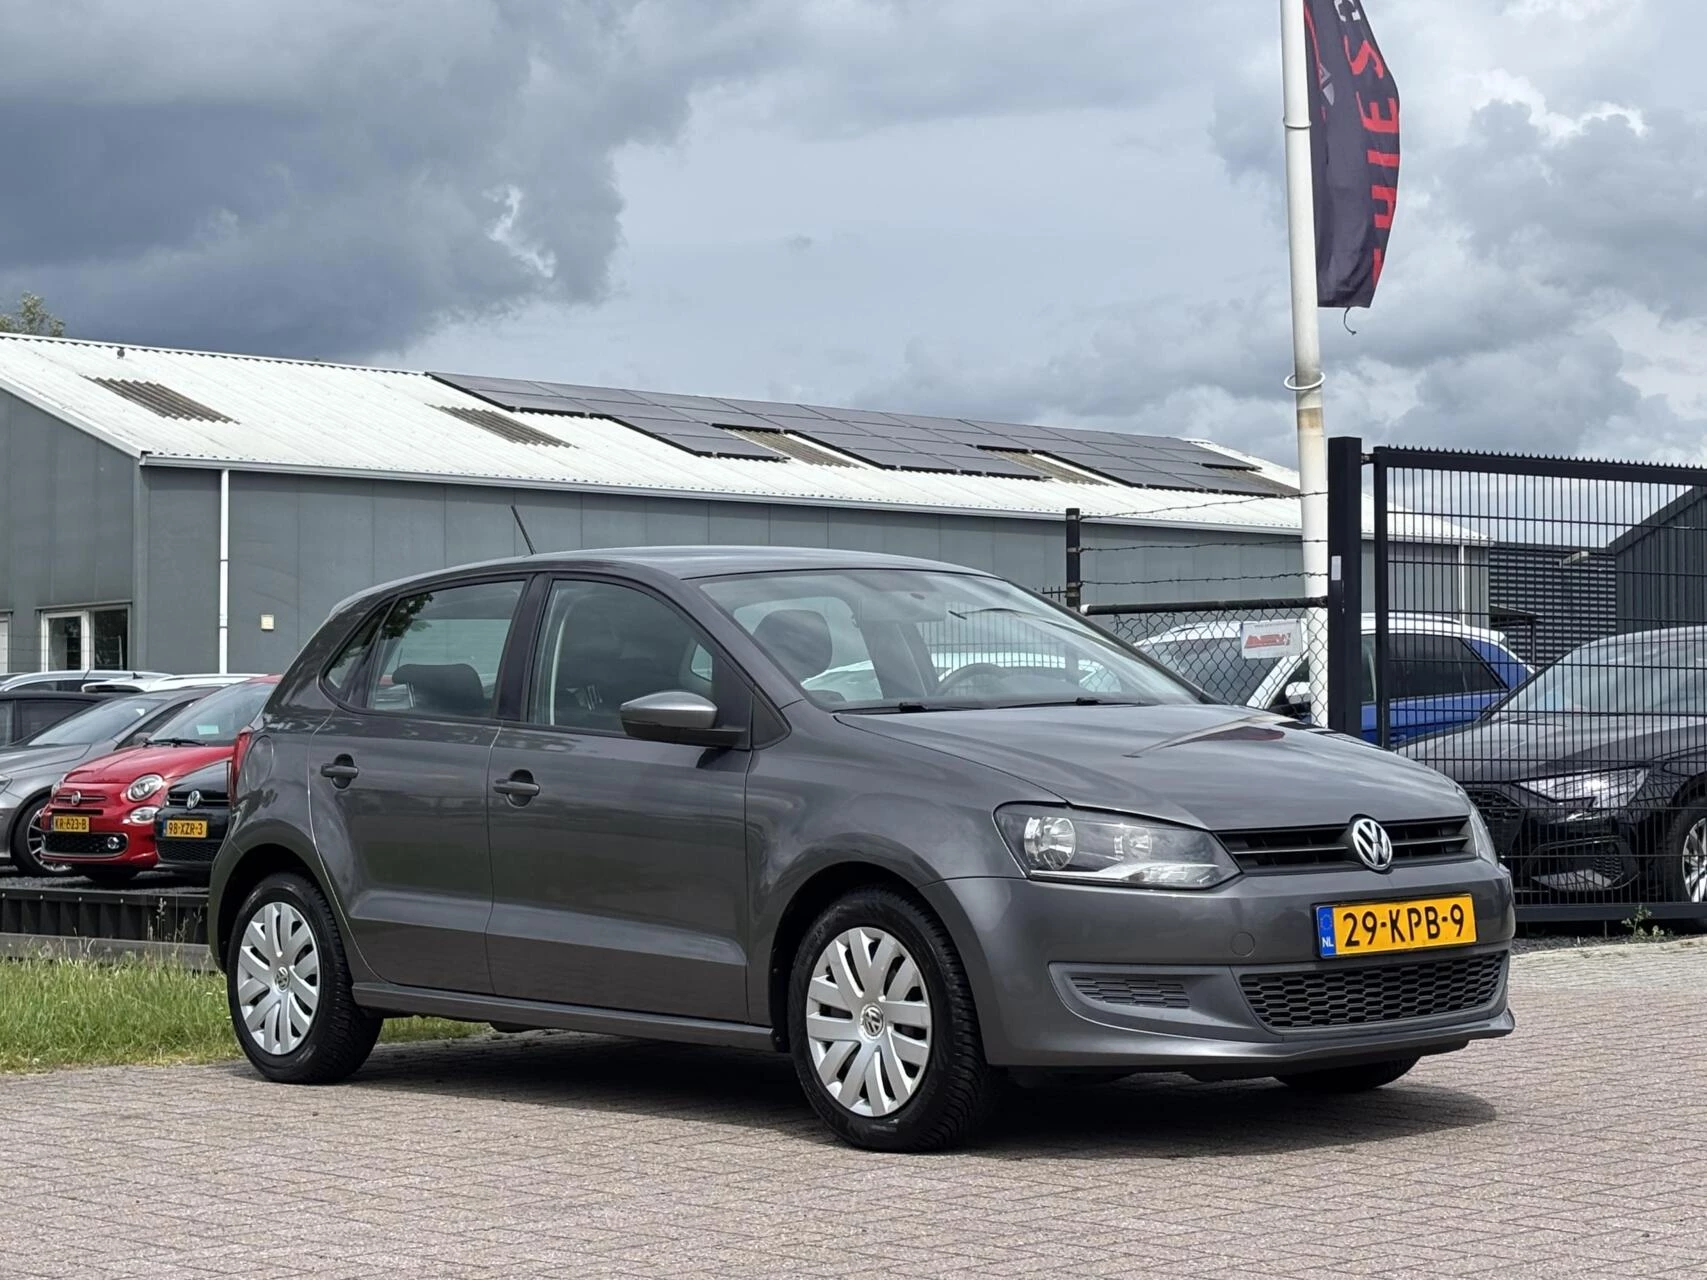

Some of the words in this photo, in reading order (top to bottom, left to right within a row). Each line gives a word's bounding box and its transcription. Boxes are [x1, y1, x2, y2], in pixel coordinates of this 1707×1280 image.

[1344, 35, 1399, 288] HIES
[168, 822, 203, 835] 98-XZR-3
[1343, 903, 1465, 947] 29-KPB-9
[1321, 936, 1335, 948] NL
